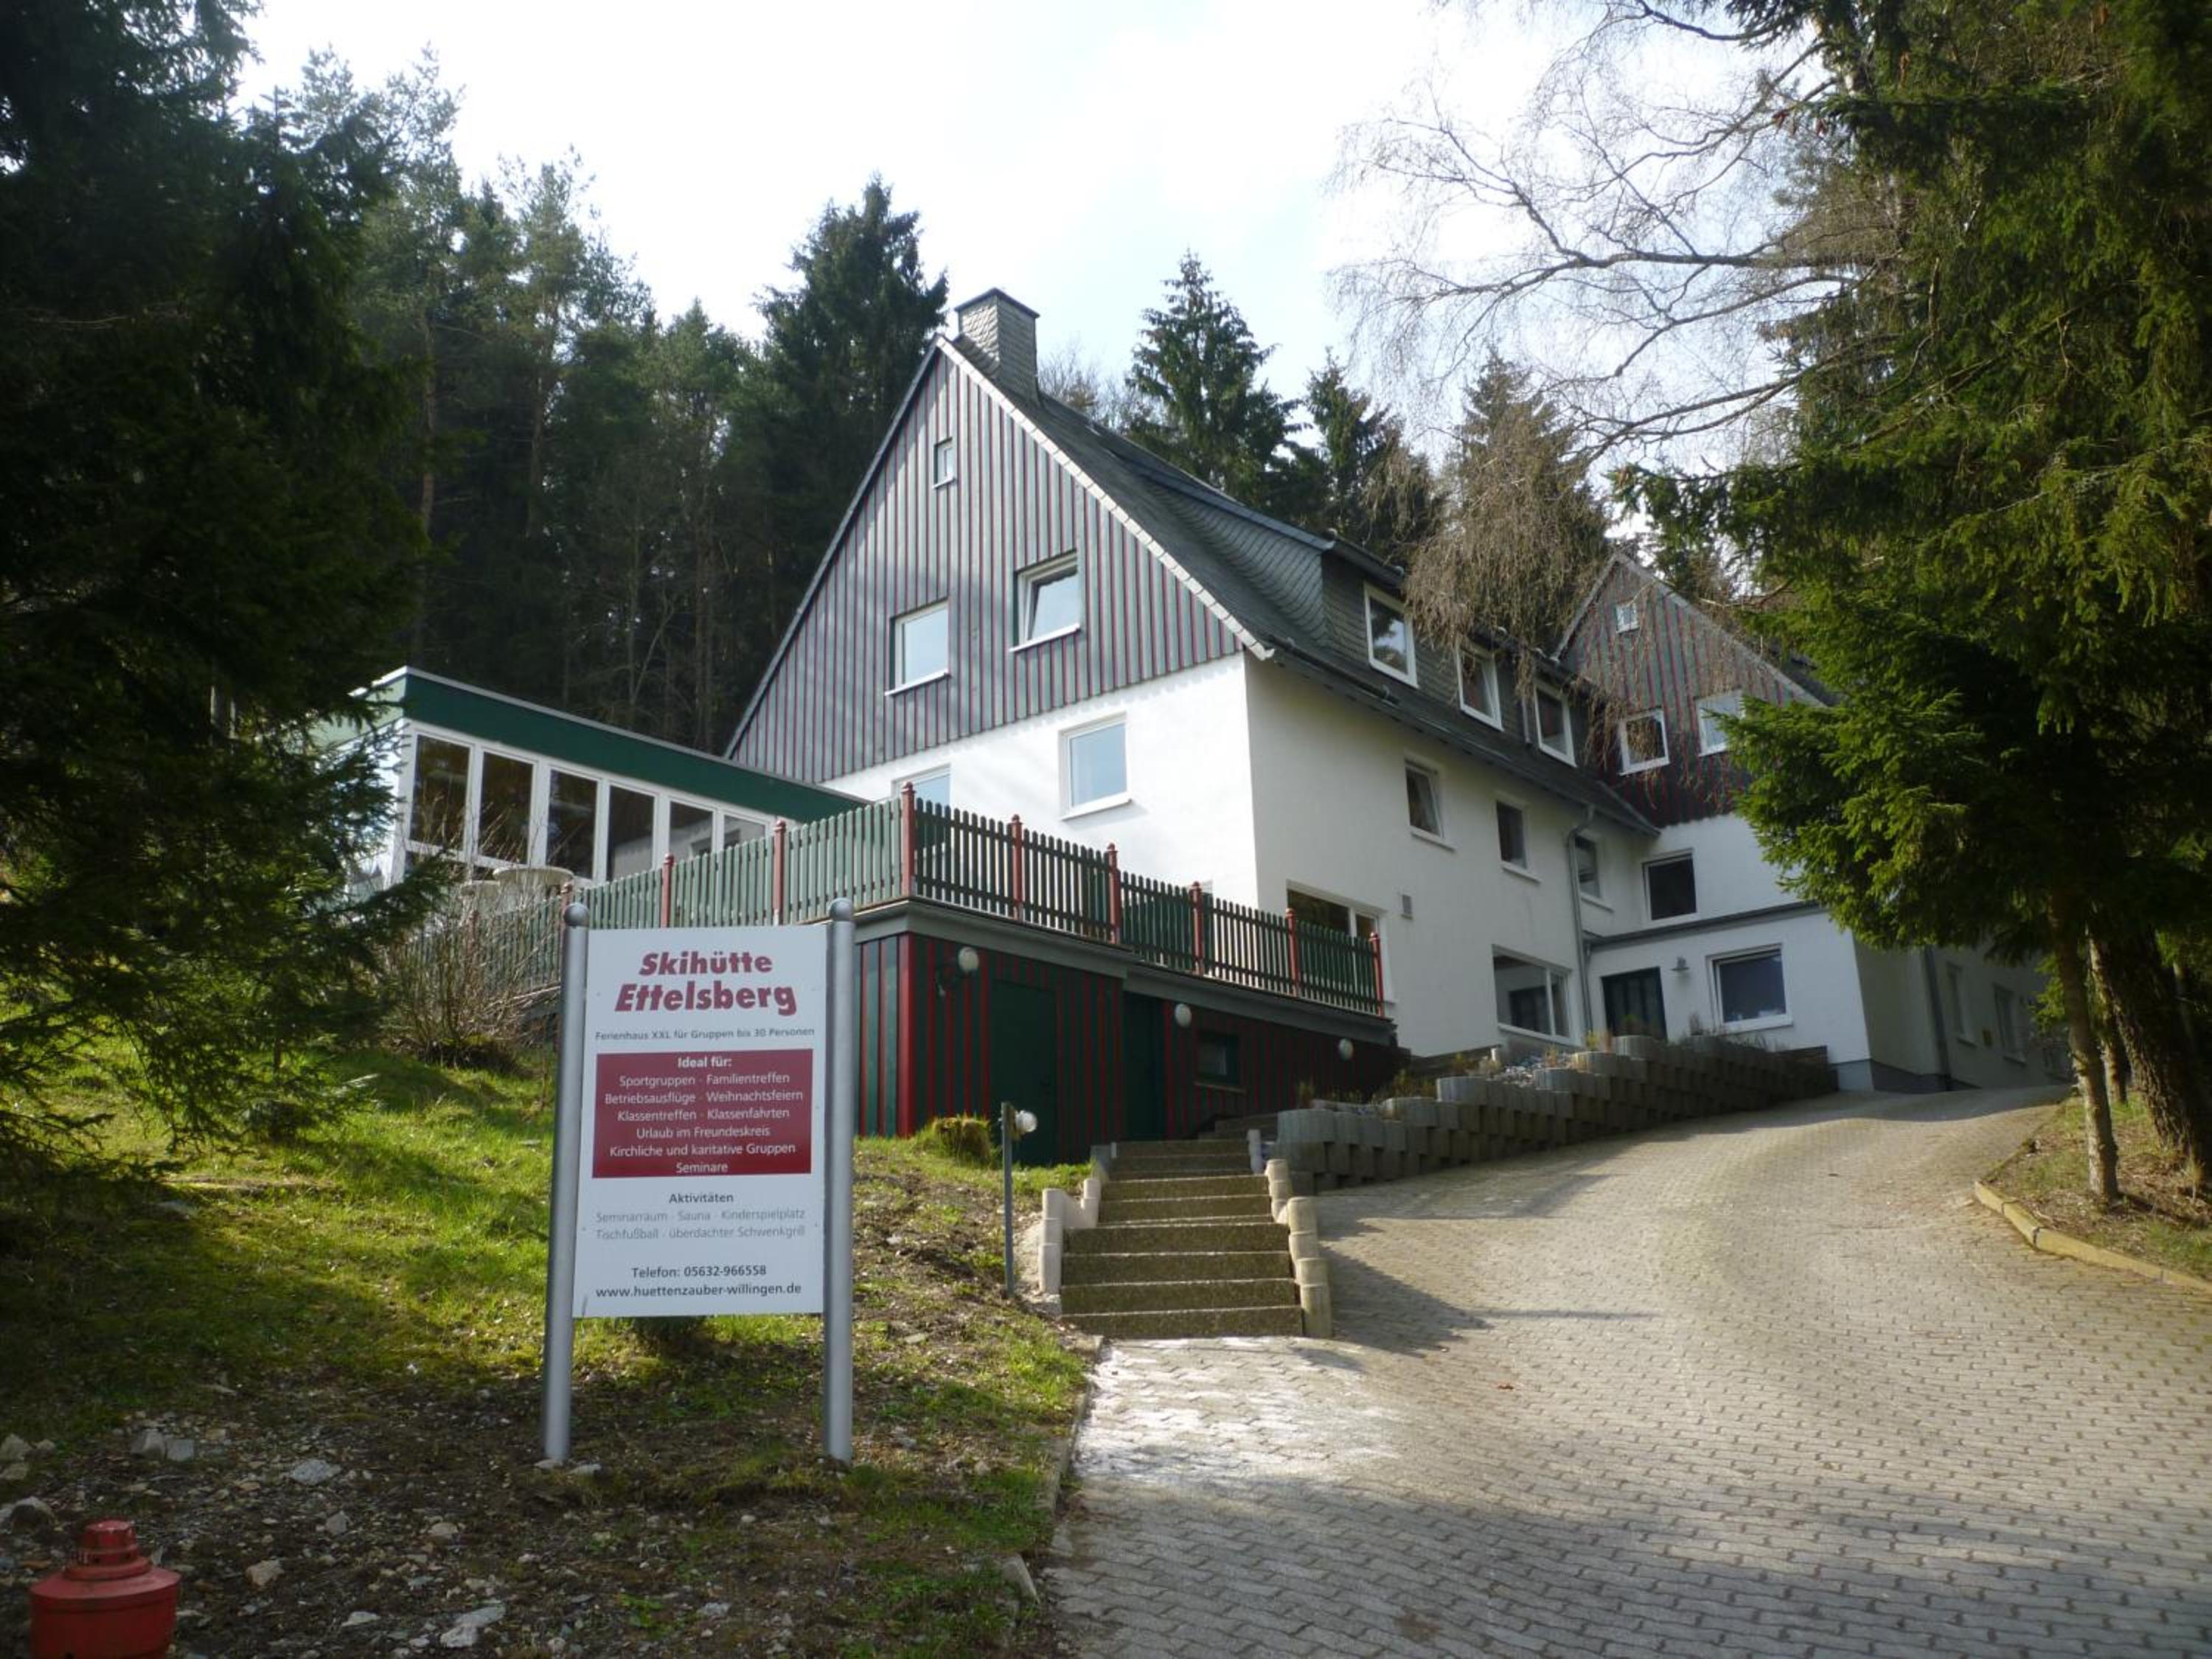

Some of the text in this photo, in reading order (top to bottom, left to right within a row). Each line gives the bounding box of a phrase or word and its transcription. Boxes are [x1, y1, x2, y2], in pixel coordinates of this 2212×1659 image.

[639, 950, 773, 975] Skihütte
[614, 981, 797, 1016] Ettelsberg
[595, 1032, 649, 1040] Ferienhaus
[651, 1031, 671, 1039] XXL
[673, 1029, 688, 1039] für
[691, 1030, 734, 1040] Gruppen
[737, 1029, 751, 1037] bis
[769, 1027, 815, 1037] Personen
[678, 1055, 732, 1068] Ideal für:
[619, 1072, 790, 1089] Sportgruppen Familientreffen
[605, 1090, 803, 1105] Betriebsausflüge Weihnachtsfeiern
[617, 1107, 790, 1121] Klassentreffen Klassenfahrten
[636, 1126, 771, 1138] Urlaub im Freundeskreis
[610, 1143, 796, 1157] Kirchliche und karitative Gruppen
[676, 1162, 728, 1174] Seminare
[669, 1192, 734, 1204] Aktivitäten
[631, 1265, 767, 1278] Telefon: 05632-966558
[595, 1282, 802, 1298] www.huettenzauber-willingen.de
